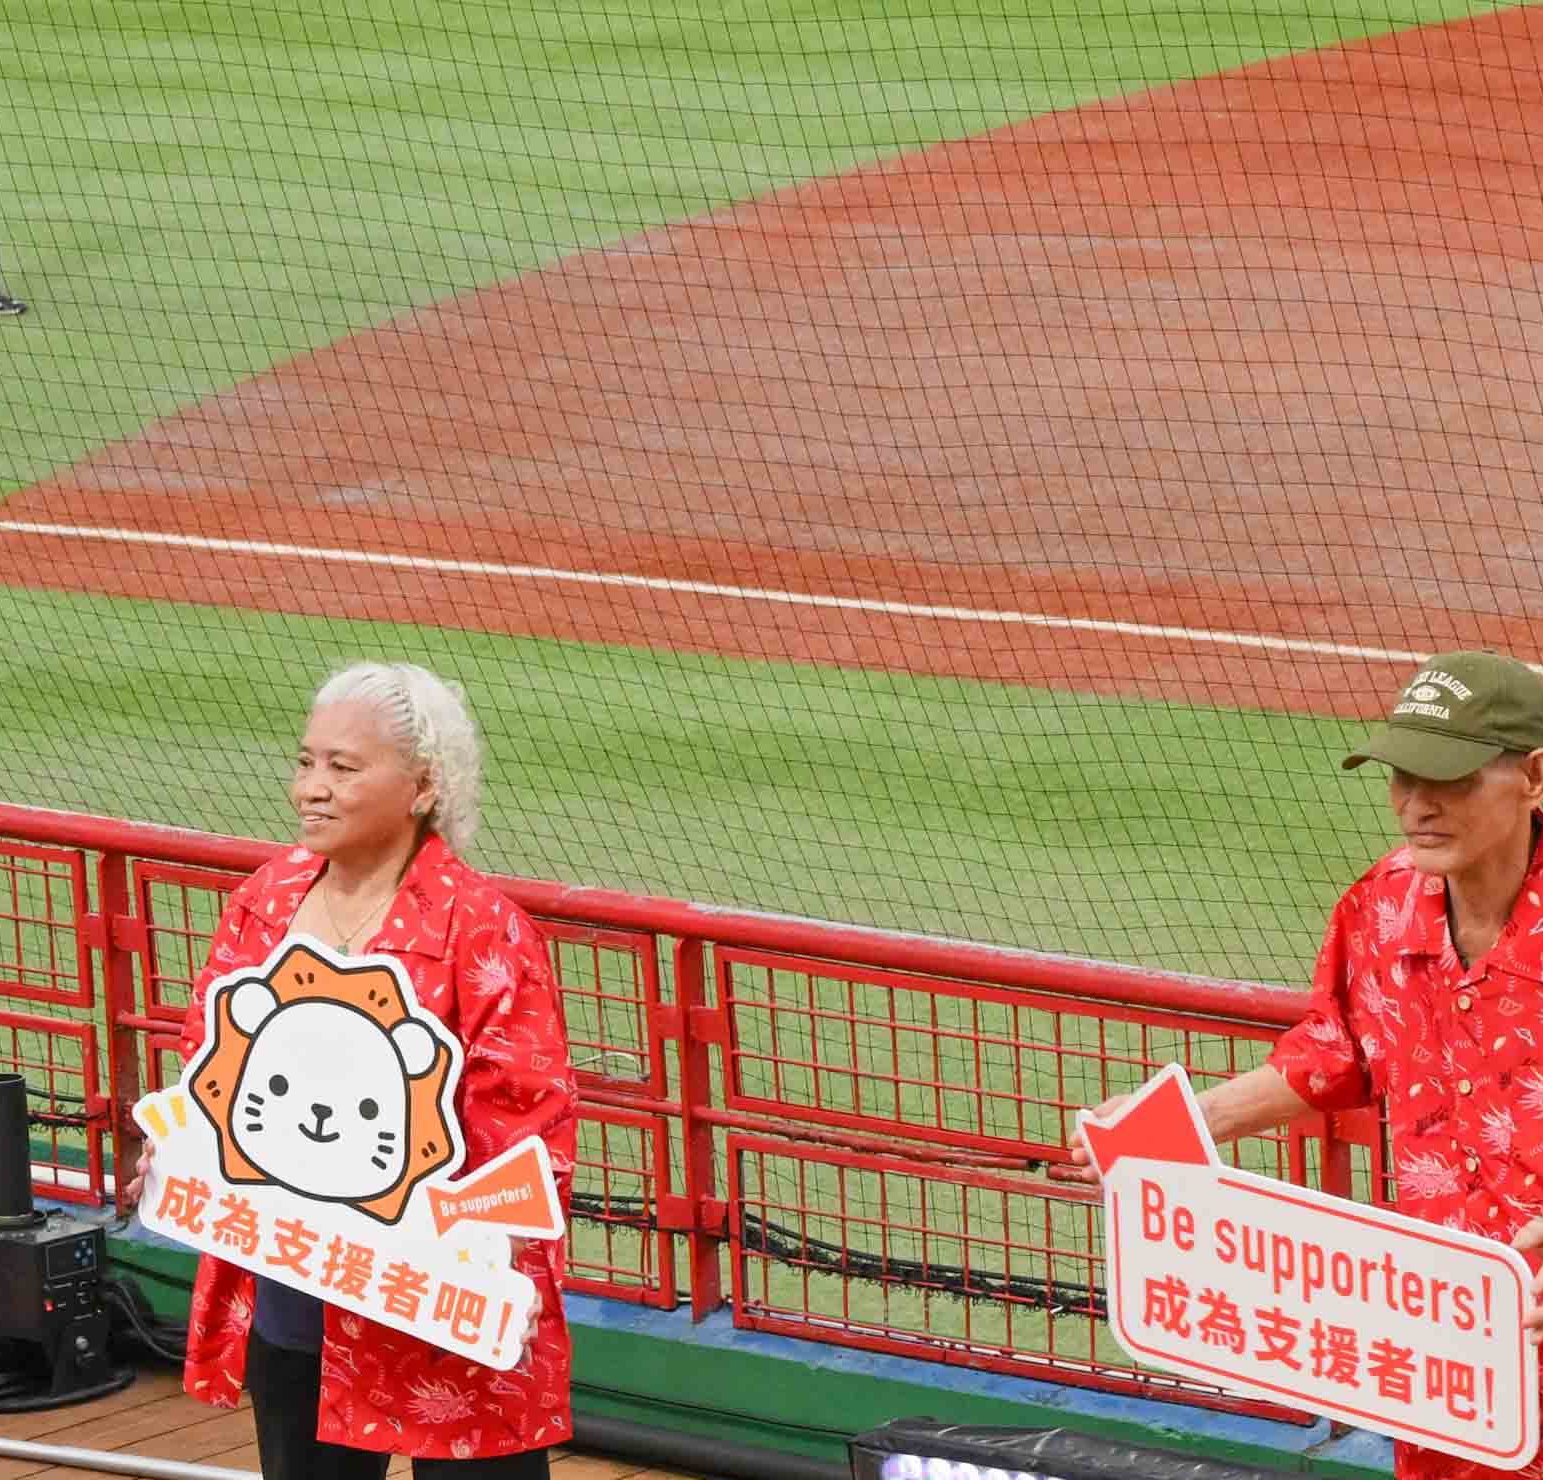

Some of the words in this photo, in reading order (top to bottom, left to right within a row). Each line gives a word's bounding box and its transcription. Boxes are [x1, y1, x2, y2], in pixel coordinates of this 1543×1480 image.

[157, 1175, 514, 1357] 成為支援者吧!
[439, 1199, 458, 1217] Be
[459, 1182, 532, 1215] supporters!
[1140, 1178, 1196, 1253] Be
[1213, 1217, 1494, 1340] supporters!
[1144, 1273, 1497, 1430] 成為支援者吧!
